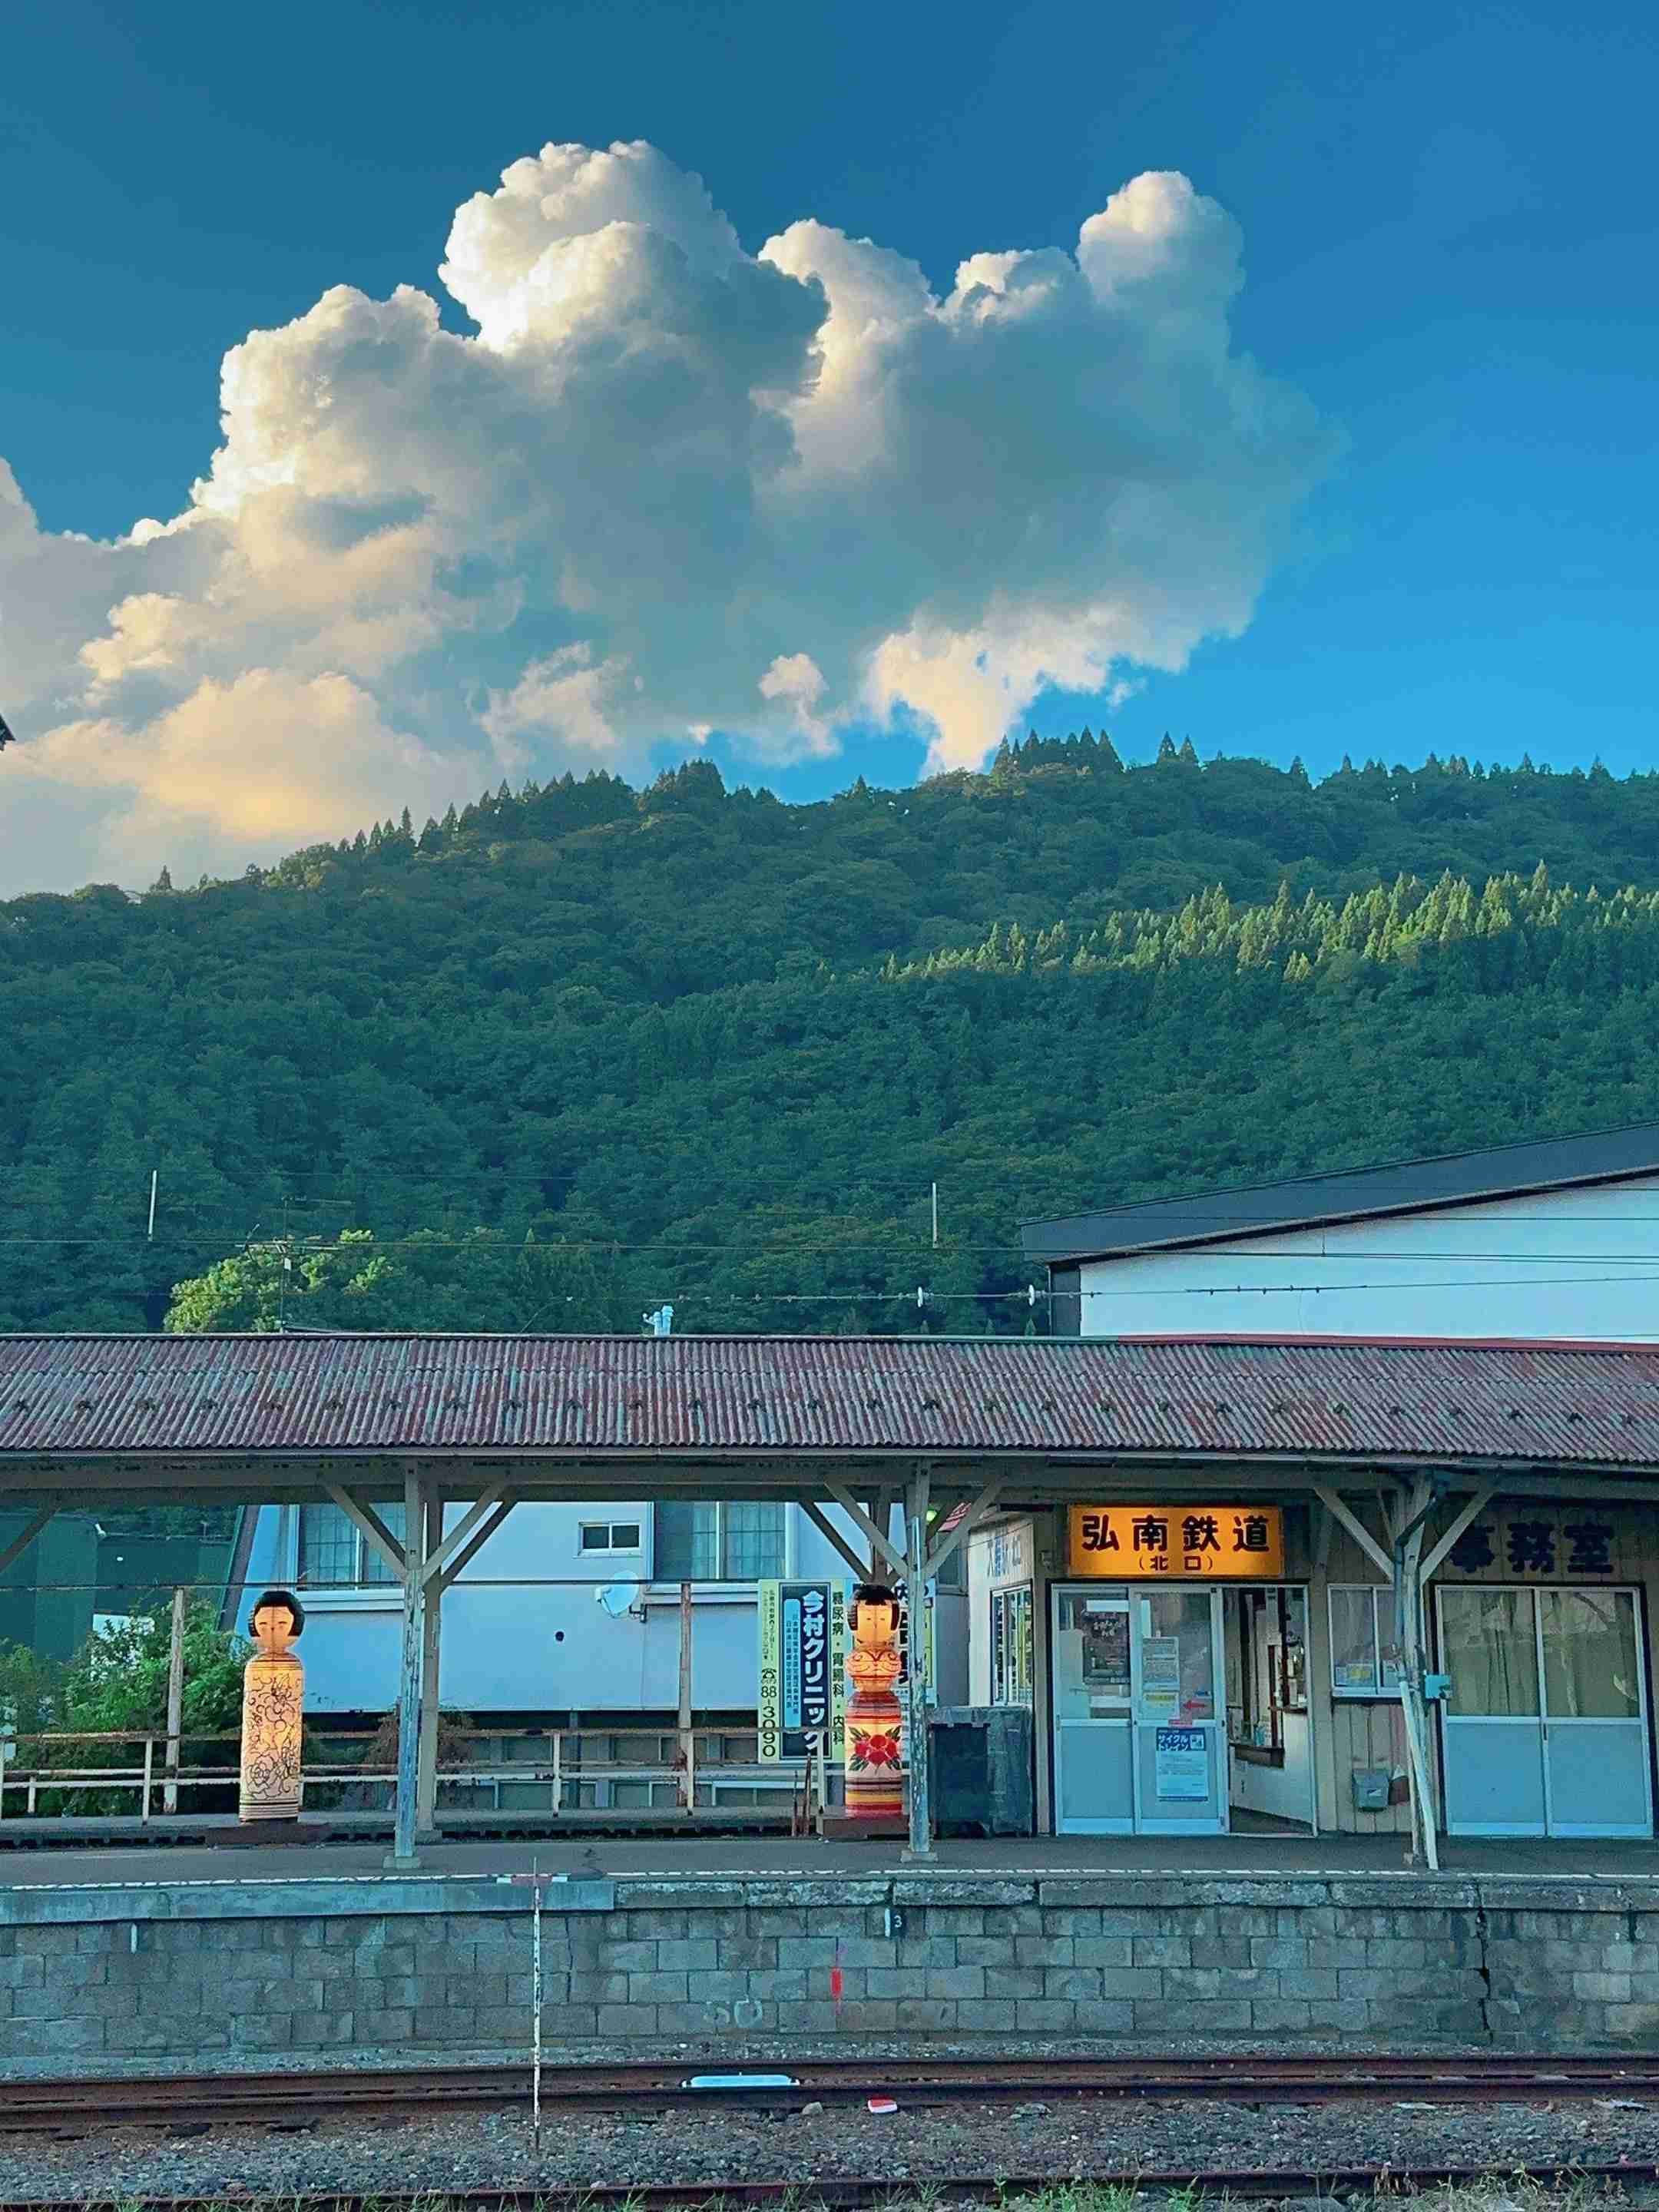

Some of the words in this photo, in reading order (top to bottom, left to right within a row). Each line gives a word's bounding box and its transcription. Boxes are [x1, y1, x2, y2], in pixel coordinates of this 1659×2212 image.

[1081, 1515, 1270, 1551] 弘南鉄道
[1139, 1555, 1214, 1571] (北口)
[802, 1590, 826, 1750] 今村クリニック
[893, 1915, 902, 1929] 3
